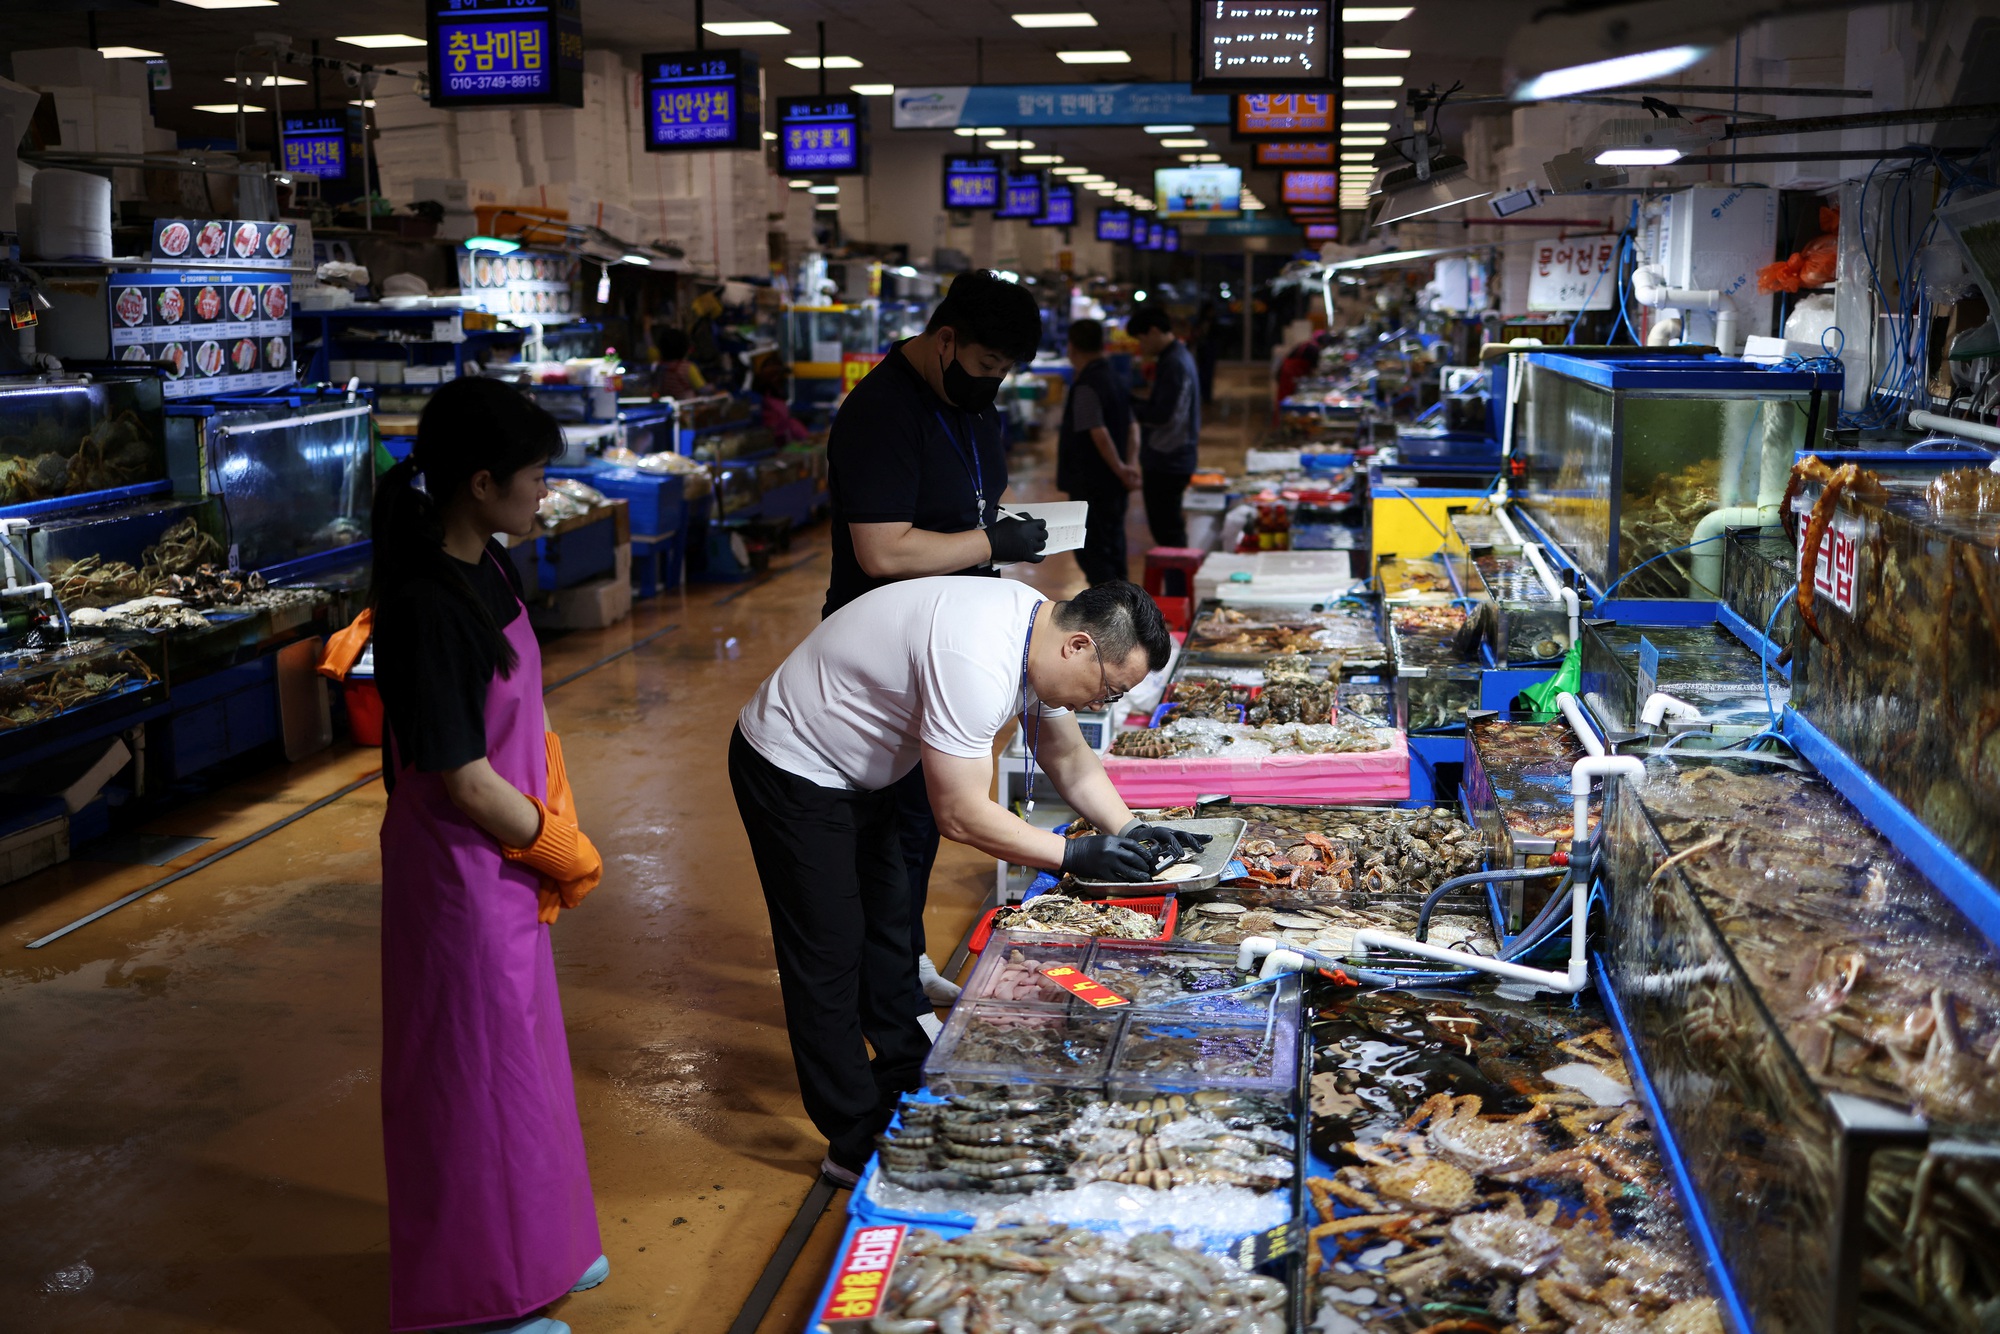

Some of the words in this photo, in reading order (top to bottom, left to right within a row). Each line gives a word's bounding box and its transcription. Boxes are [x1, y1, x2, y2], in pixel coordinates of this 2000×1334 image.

[448, 29, 541, 72] 충남미림
[701, 60, 727, 75] 129
[451, 75, 541, 90] 010-3749-8915
[658, 91, 729, 124] 신안상회
[286, 140, 340, 166] 탐나전복
[1720, 188, 1743, 210] HIPL
[1538, 244, 1613, 277] 문어전문
